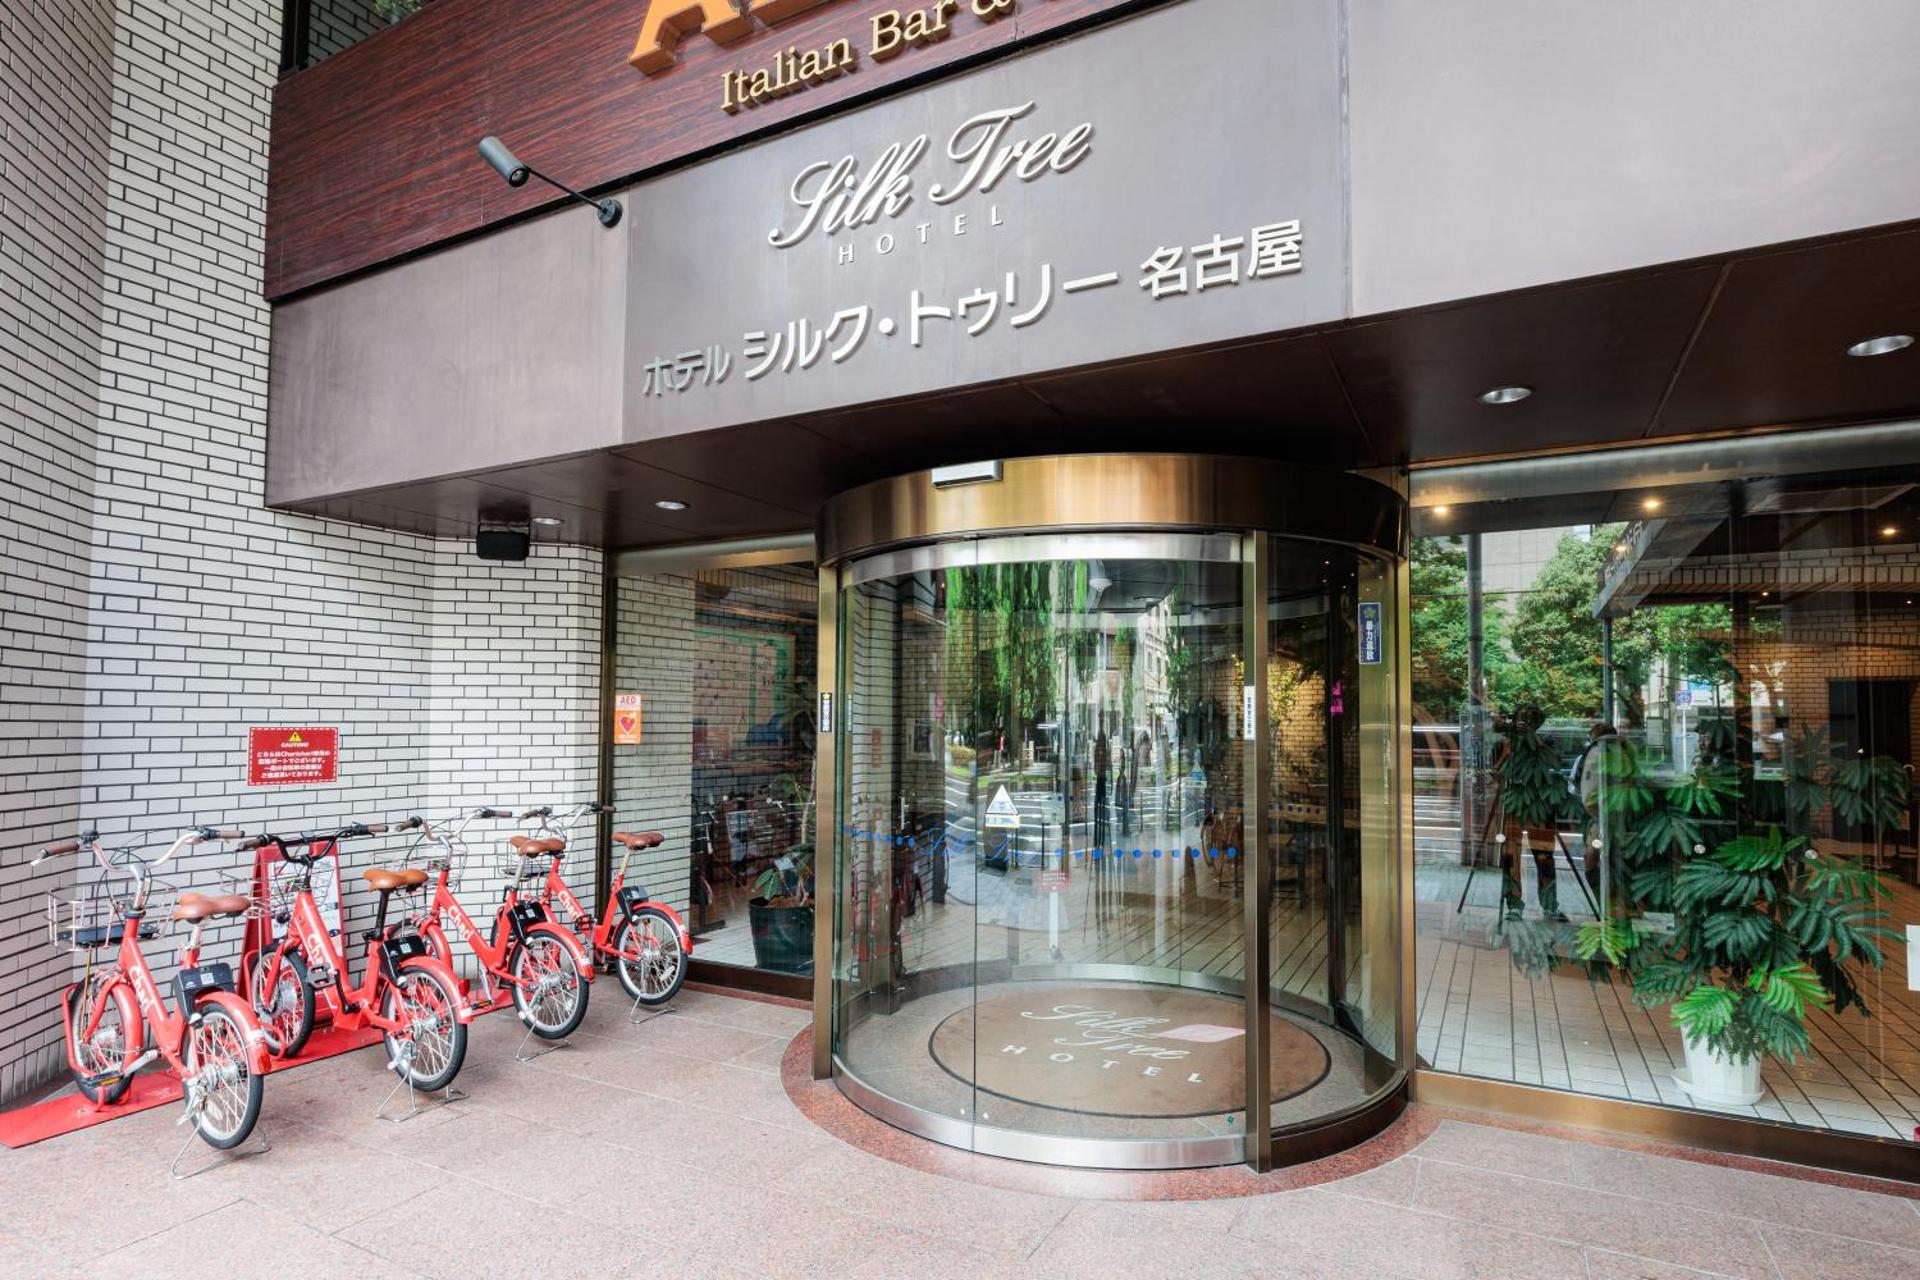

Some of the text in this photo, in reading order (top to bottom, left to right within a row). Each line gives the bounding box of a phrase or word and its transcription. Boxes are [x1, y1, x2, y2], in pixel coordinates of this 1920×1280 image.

[720, 37, 858, 113] Italian
[868, 0, 955, 60] Bar
[768, 100, 1092, 249] Silk Tree
[838, 205, 1004, 266] HOTEL
[642, 344, 732, 397] ホテル
[1138, 218, 1304, 299] 名古屋
[620, 695, 636, 704] AED
[1000, 1043, 1203, 1084] HOTEL
